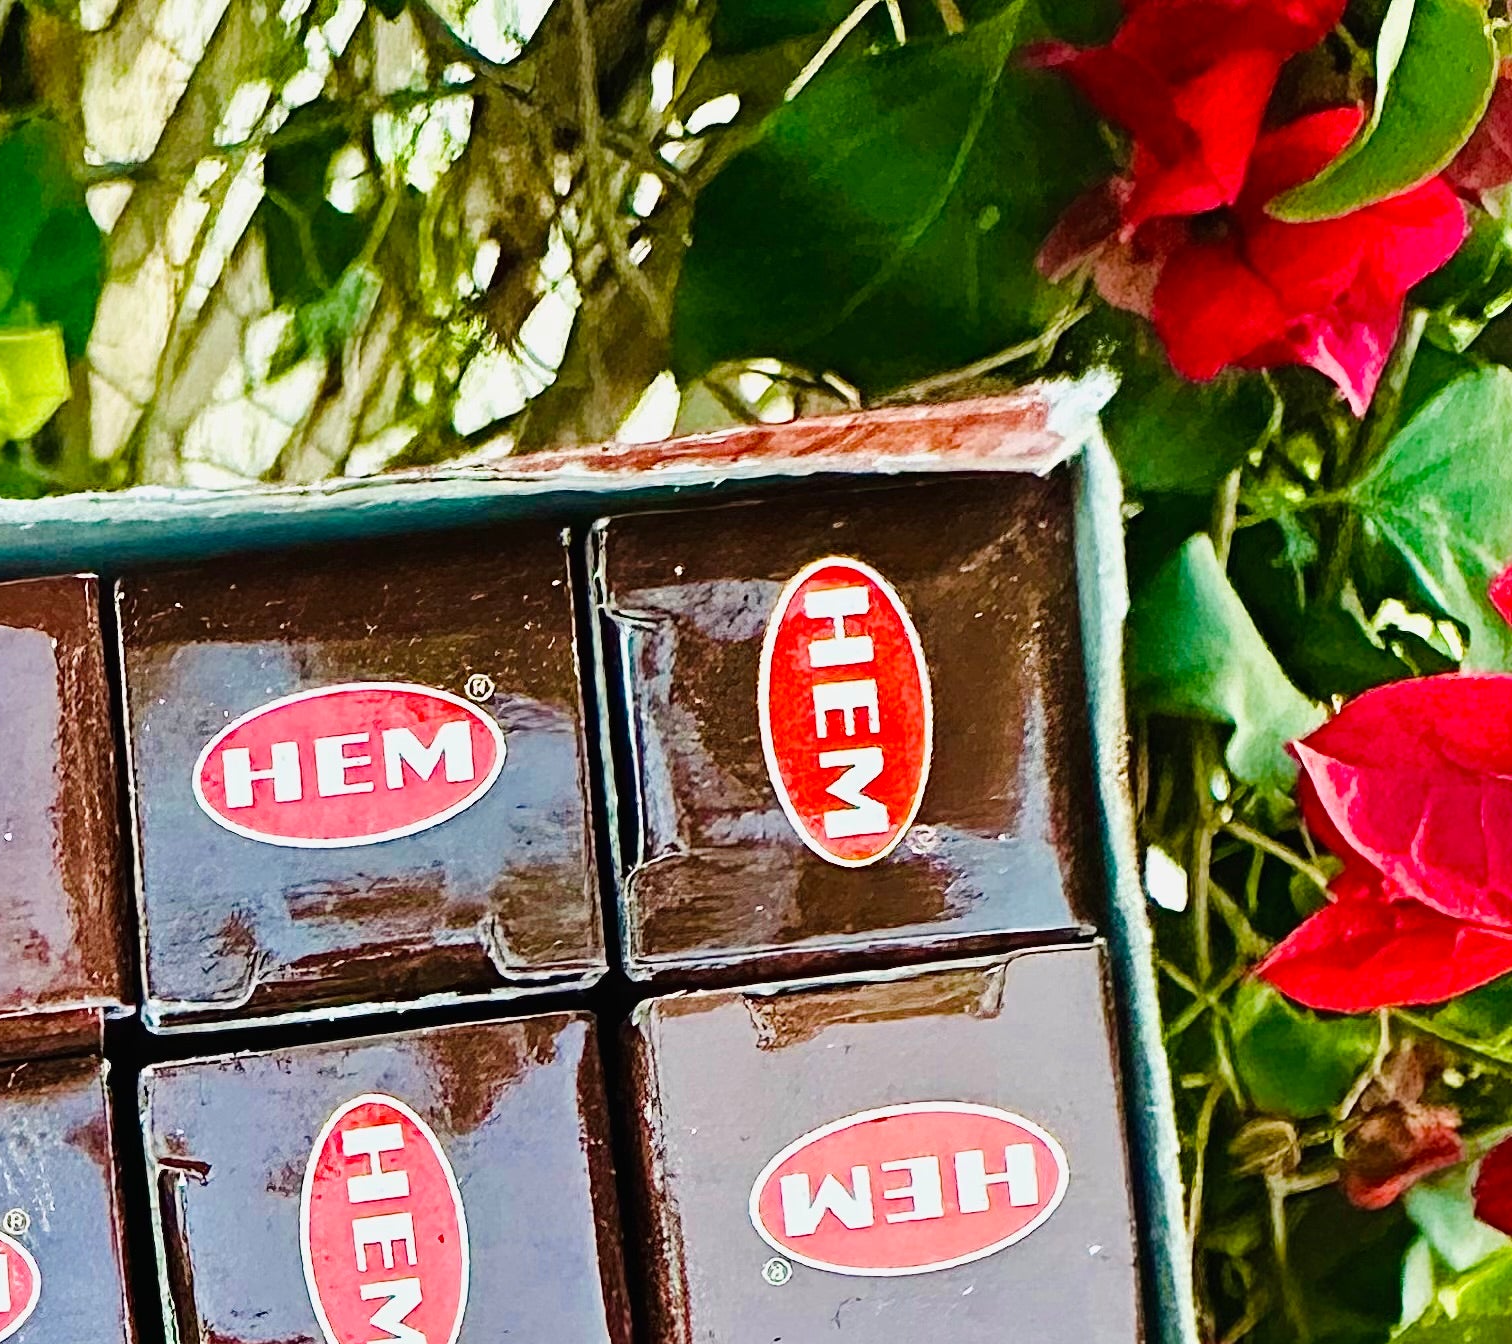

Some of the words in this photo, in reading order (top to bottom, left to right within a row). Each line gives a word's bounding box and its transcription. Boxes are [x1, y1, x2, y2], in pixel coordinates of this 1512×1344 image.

[804, 587, 888, 838] HEM
[223, 721, 473, 807] HEM
[780, 1144, 1038, 1236] HEM
